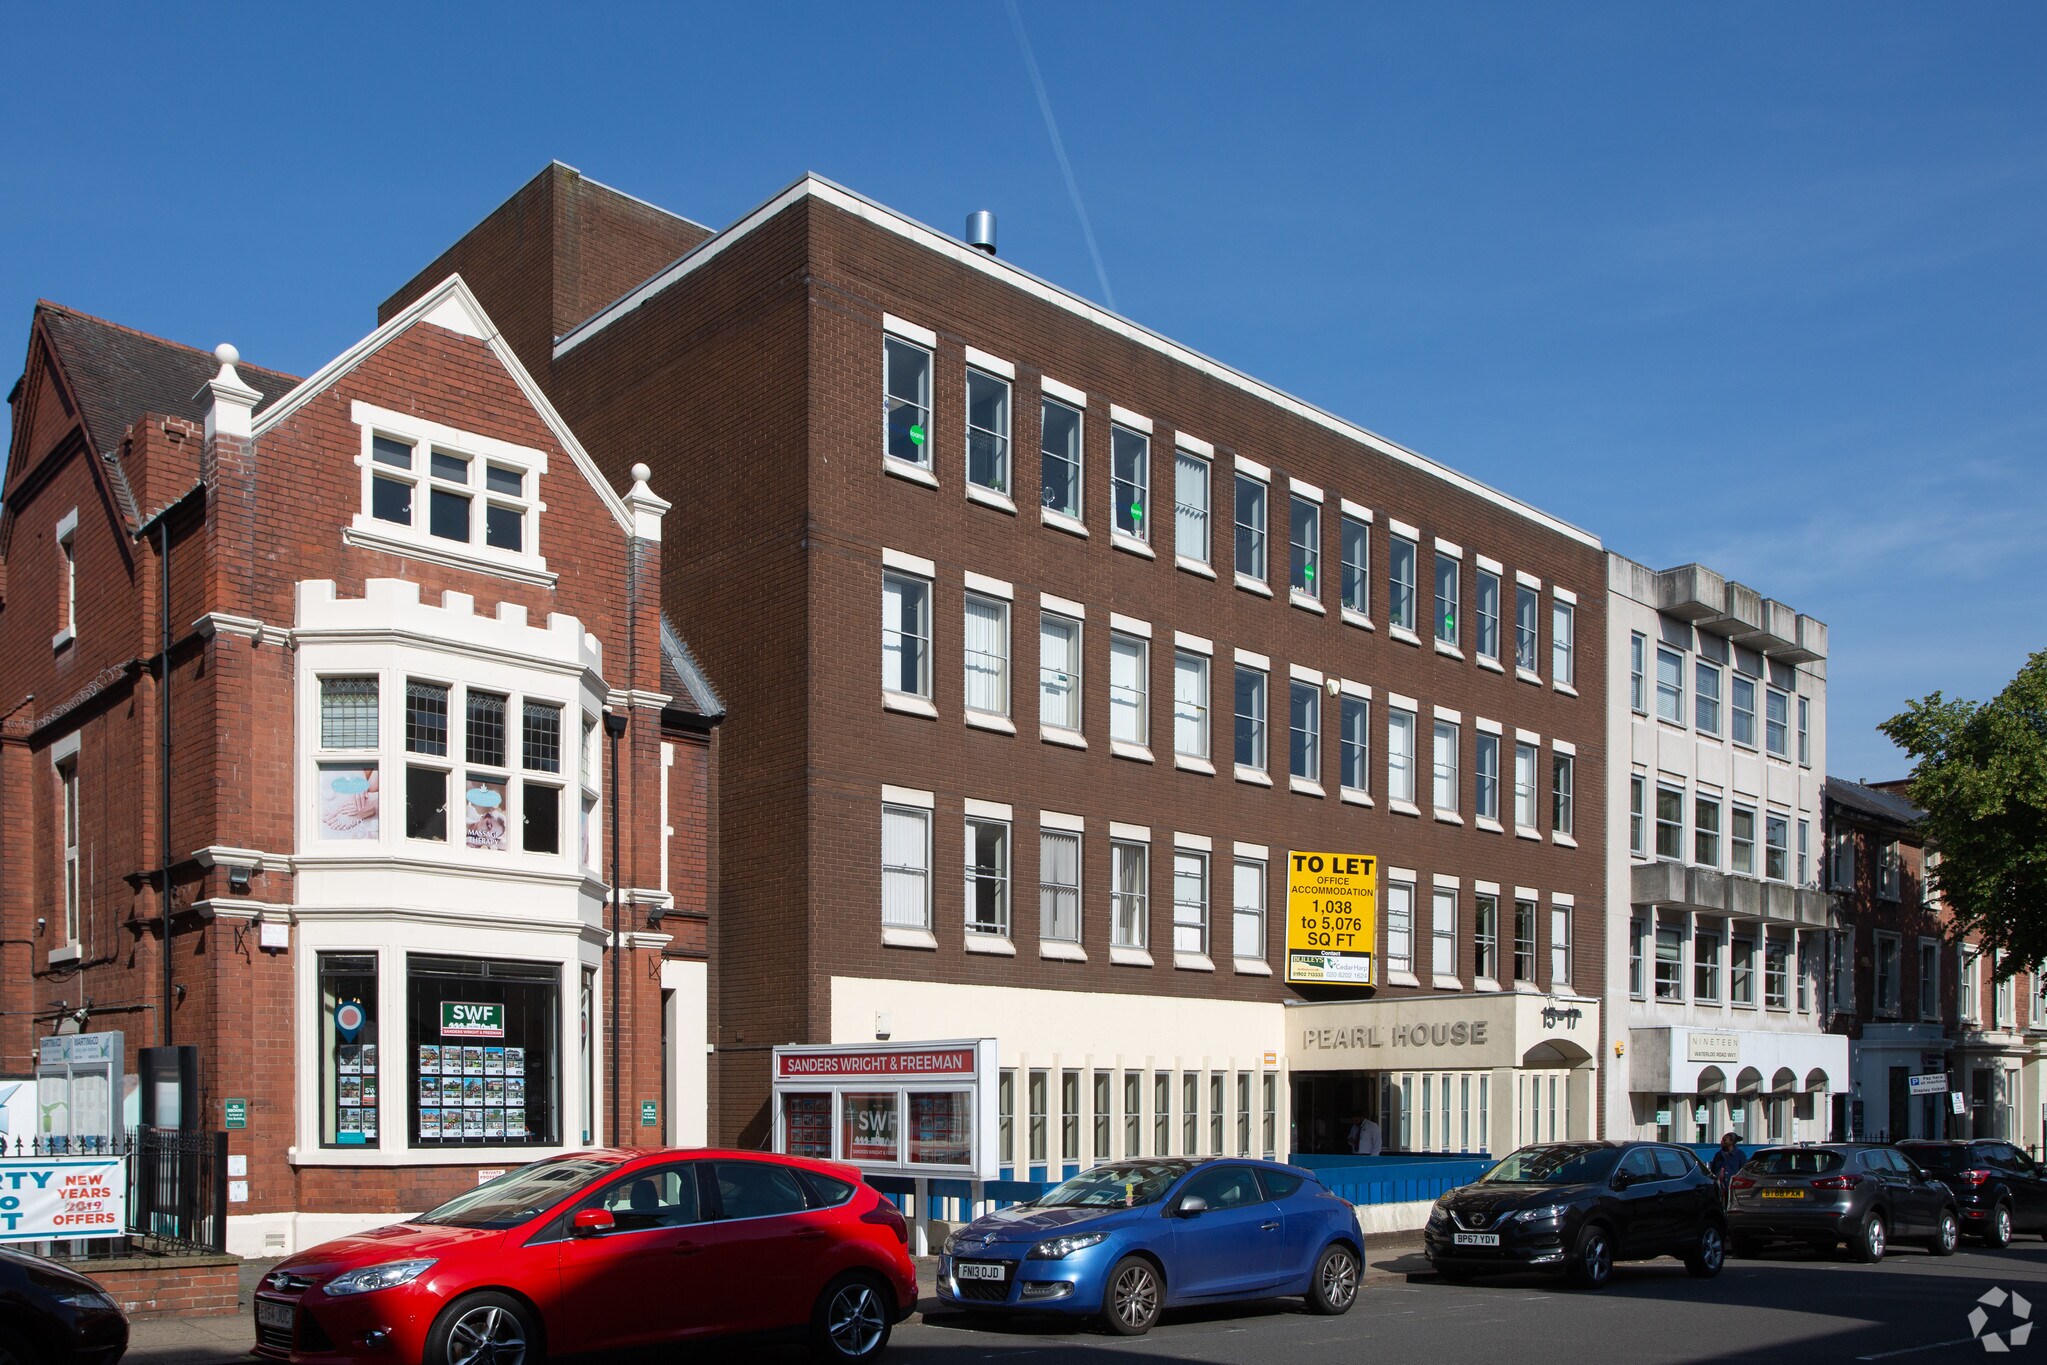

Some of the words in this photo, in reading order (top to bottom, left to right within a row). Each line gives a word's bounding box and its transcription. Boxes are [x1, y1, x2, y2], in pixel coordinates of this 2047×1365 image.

[468, 829, 498, 838] MASSAGE
[469, 837, 498, 845] THERAPY
[1293, 855, 1324, 873] TO
[1333, 857, 1374, 875] LET
[1317, 876, 1349, 885] OFFICE
[1292, 886, 1373, 896] ACCOMMODATION
[1312, 900, 1352, 915] 1,038
[1301, 916, 1316, 929] to
[1322, 917, 1361, 932] 5,076
[1308, 932, 1330, 946] SQ
[1336, 933, 1355, 947] FT
[453, 1005, 493, 1020] SWF
[1303, 1025, 1384, 1050] PEARL
[1392, 1020, 1488, 1048] HOUSE
[1692, 1038, 1738, 1046] NINETEEN
[788, 1057, 838, 1072] SANDERS
[840, 1056, 888, 1071] WRIGHT
[890, 1056, 898, 1070] &
[901, 1055, 962, 1070] FREEMAN
[859, 1110, 897, 1131] SWF
[0, 1171, 54, 1189] TY
[65, 1175, 103, 1186] NEW
[57, 1187, 111, 1199] YEARS
[66, 1201, 102, 1212] 2019
[53, 1213, 115, 1225] OFFERS
[1458, 1235, 1478, 1243] BP67
[1480, 1235, 1495, 1243] YDV
[962, 1266, 980, 1277] FN13
[981, 1267, 998, 1278] OJD
